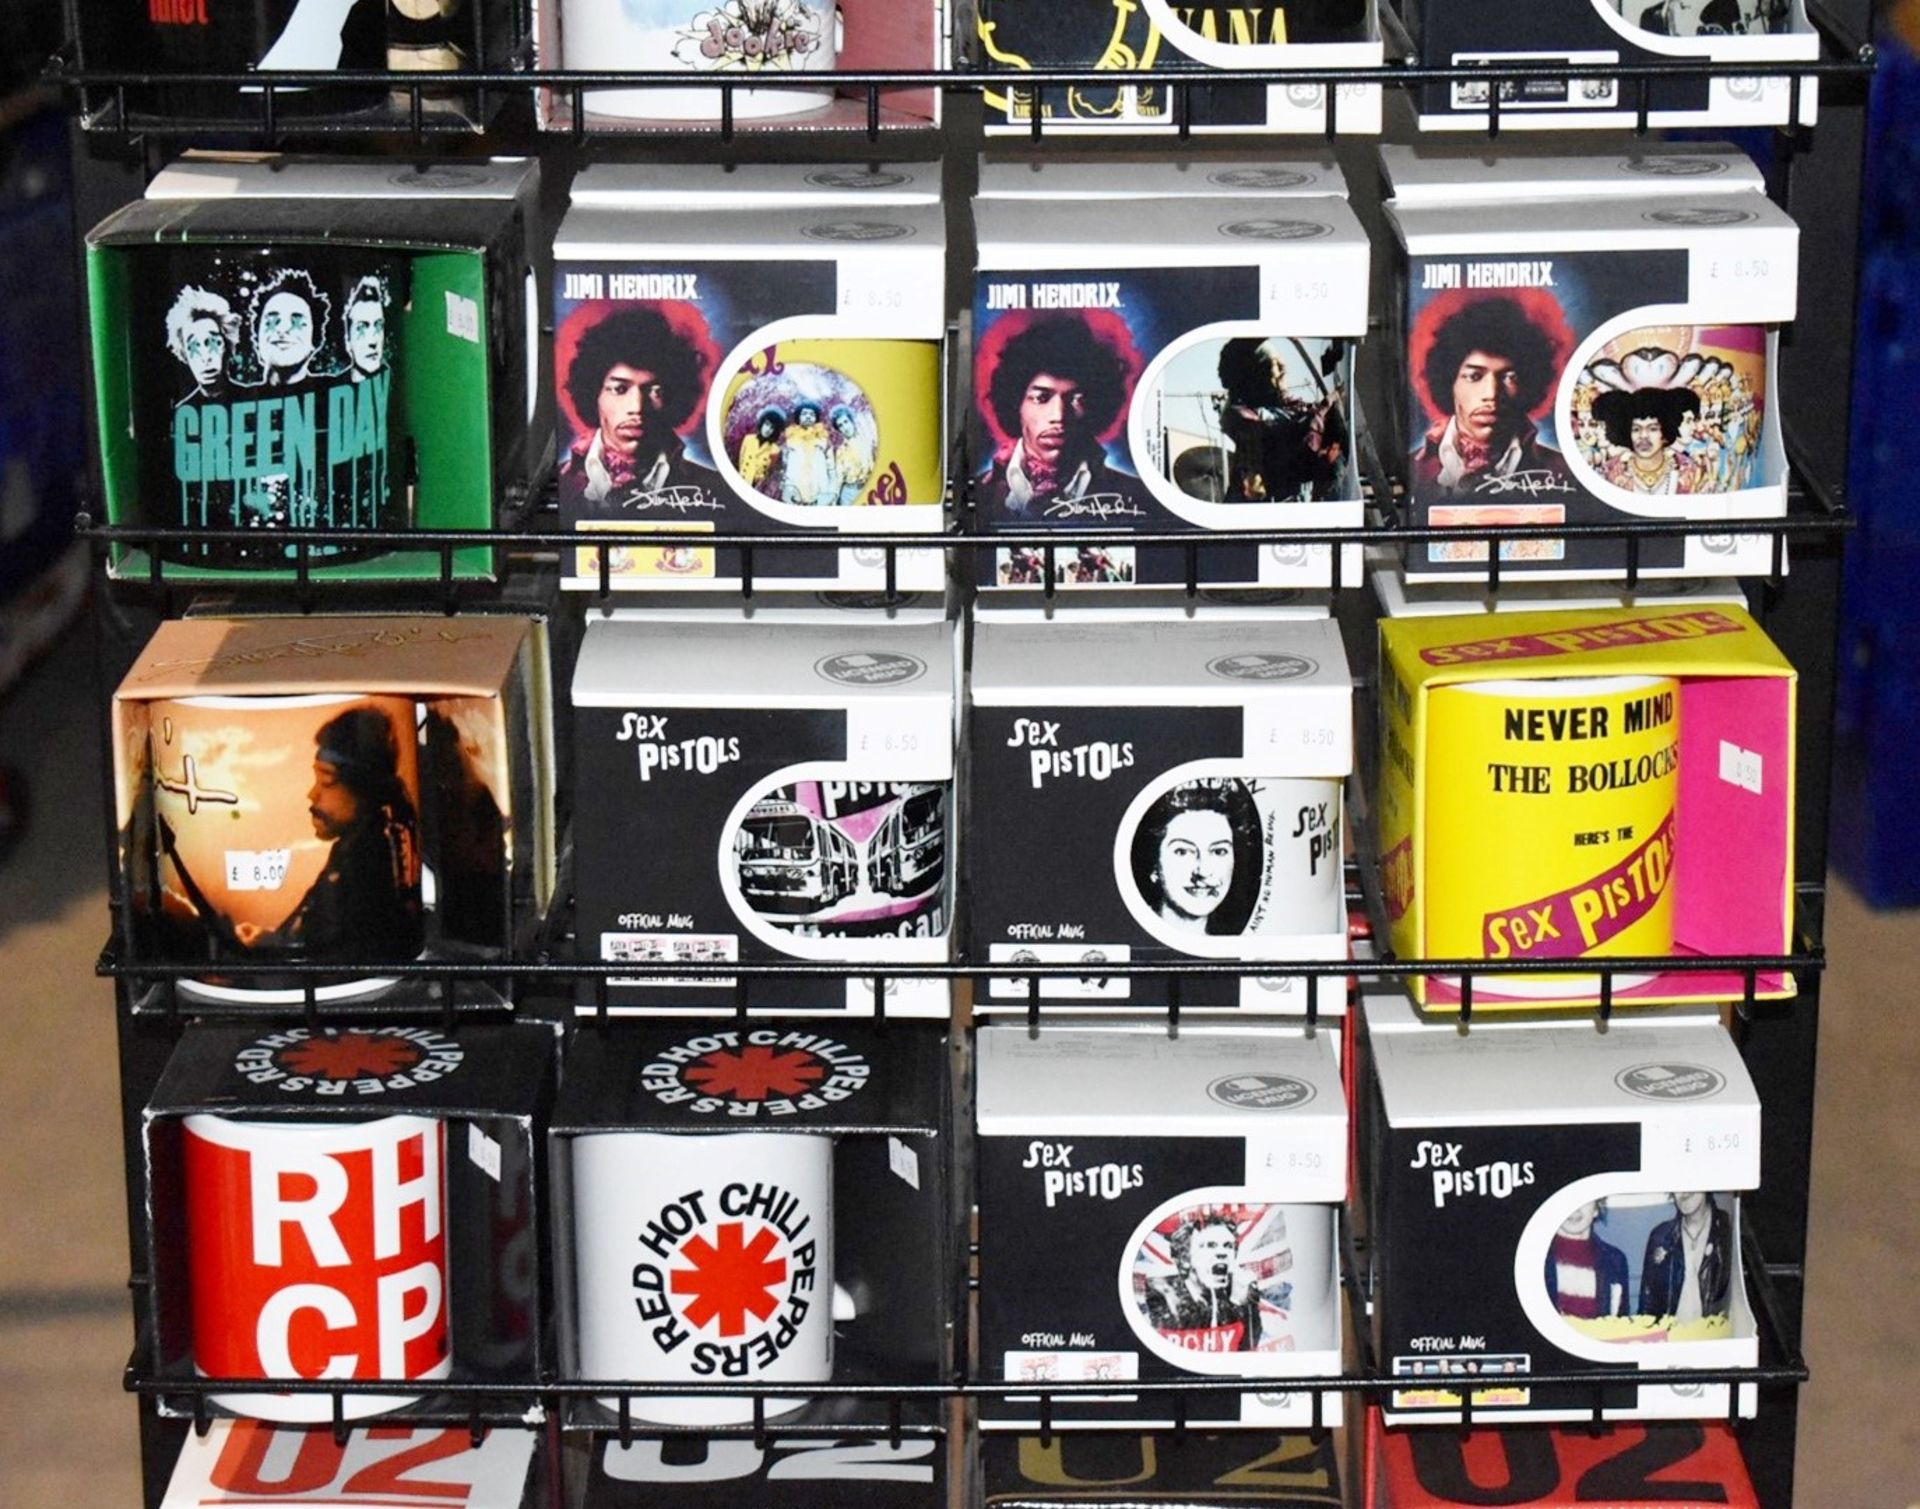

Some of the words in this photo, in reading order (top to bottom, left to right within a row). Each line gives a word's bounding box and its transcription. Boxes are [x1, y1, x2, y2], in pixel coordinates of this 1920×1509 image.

[1421, 263, 1461, 289] JIMI
[1467, 261, 1553, 288] HENDRIX
[1733, 259, 1770, 280] 8.50
[563, 274, 603, 300] JIMI
[609, 273, 699, 300] HENDRIX
[986, 283, 1026, 309] JIMI
[1032, 282, 1121, 309] HENDRIX
[174, 391, 316, 482] GREEN
[327, 368, 391, 465] DAY
[1504, 706, 1609, 741] NEVER
[1624, 691, 1673, 733] MIND
[884, 733, 919, 752] 8.50
[1301, 729, 1335, 746] 8.50
[1488, 763, 1551, 794] THE
[1574, 830, 1610, 847] HERE'S
[1617, 826, 1634, 842] THE
[231, 866, 240, 882] £
[253, 863, 286, 882] 8.00
[617, 914, 664, 930] OFFICIAL
[667, 914, 694, 930] MUG
[1007, 924, 1054, 940] OFFICIAL
[1056, 924, 1085, 940] MUG
[664, 1031, 741, 1064] HOT
[748, 1030, 850, 1065] CHILI
[235, 1048, 281, 1085] RED
[279, 1050, 464, 1096] PEPPERS
[641, 1063, 687, 1104] RED
[690, 1063, 870, 1117] PEPPERS
[1706, 1134, 1741, 1151] 8.50
[1288, 1152, 1323, 1169] 8.50
[250, 1118, 441, 1267] RH
[638, 1189, 708, 1259] HOT
[719, 1183, 811, 1243] CHILI
[256, 1261, 443, 1380] CP
[632, 1263, 690, 1354] RED
[690, 1238, 817, 1378] PEPPERS
[1021, 1332, 1067, 1348] OFFICIAL
[1069, 1332, 1096, 1348] MUG
[1409, 1336, 1456, 1352] OFFICIAL
[1459, 1334, 1487, 1350] MUG
